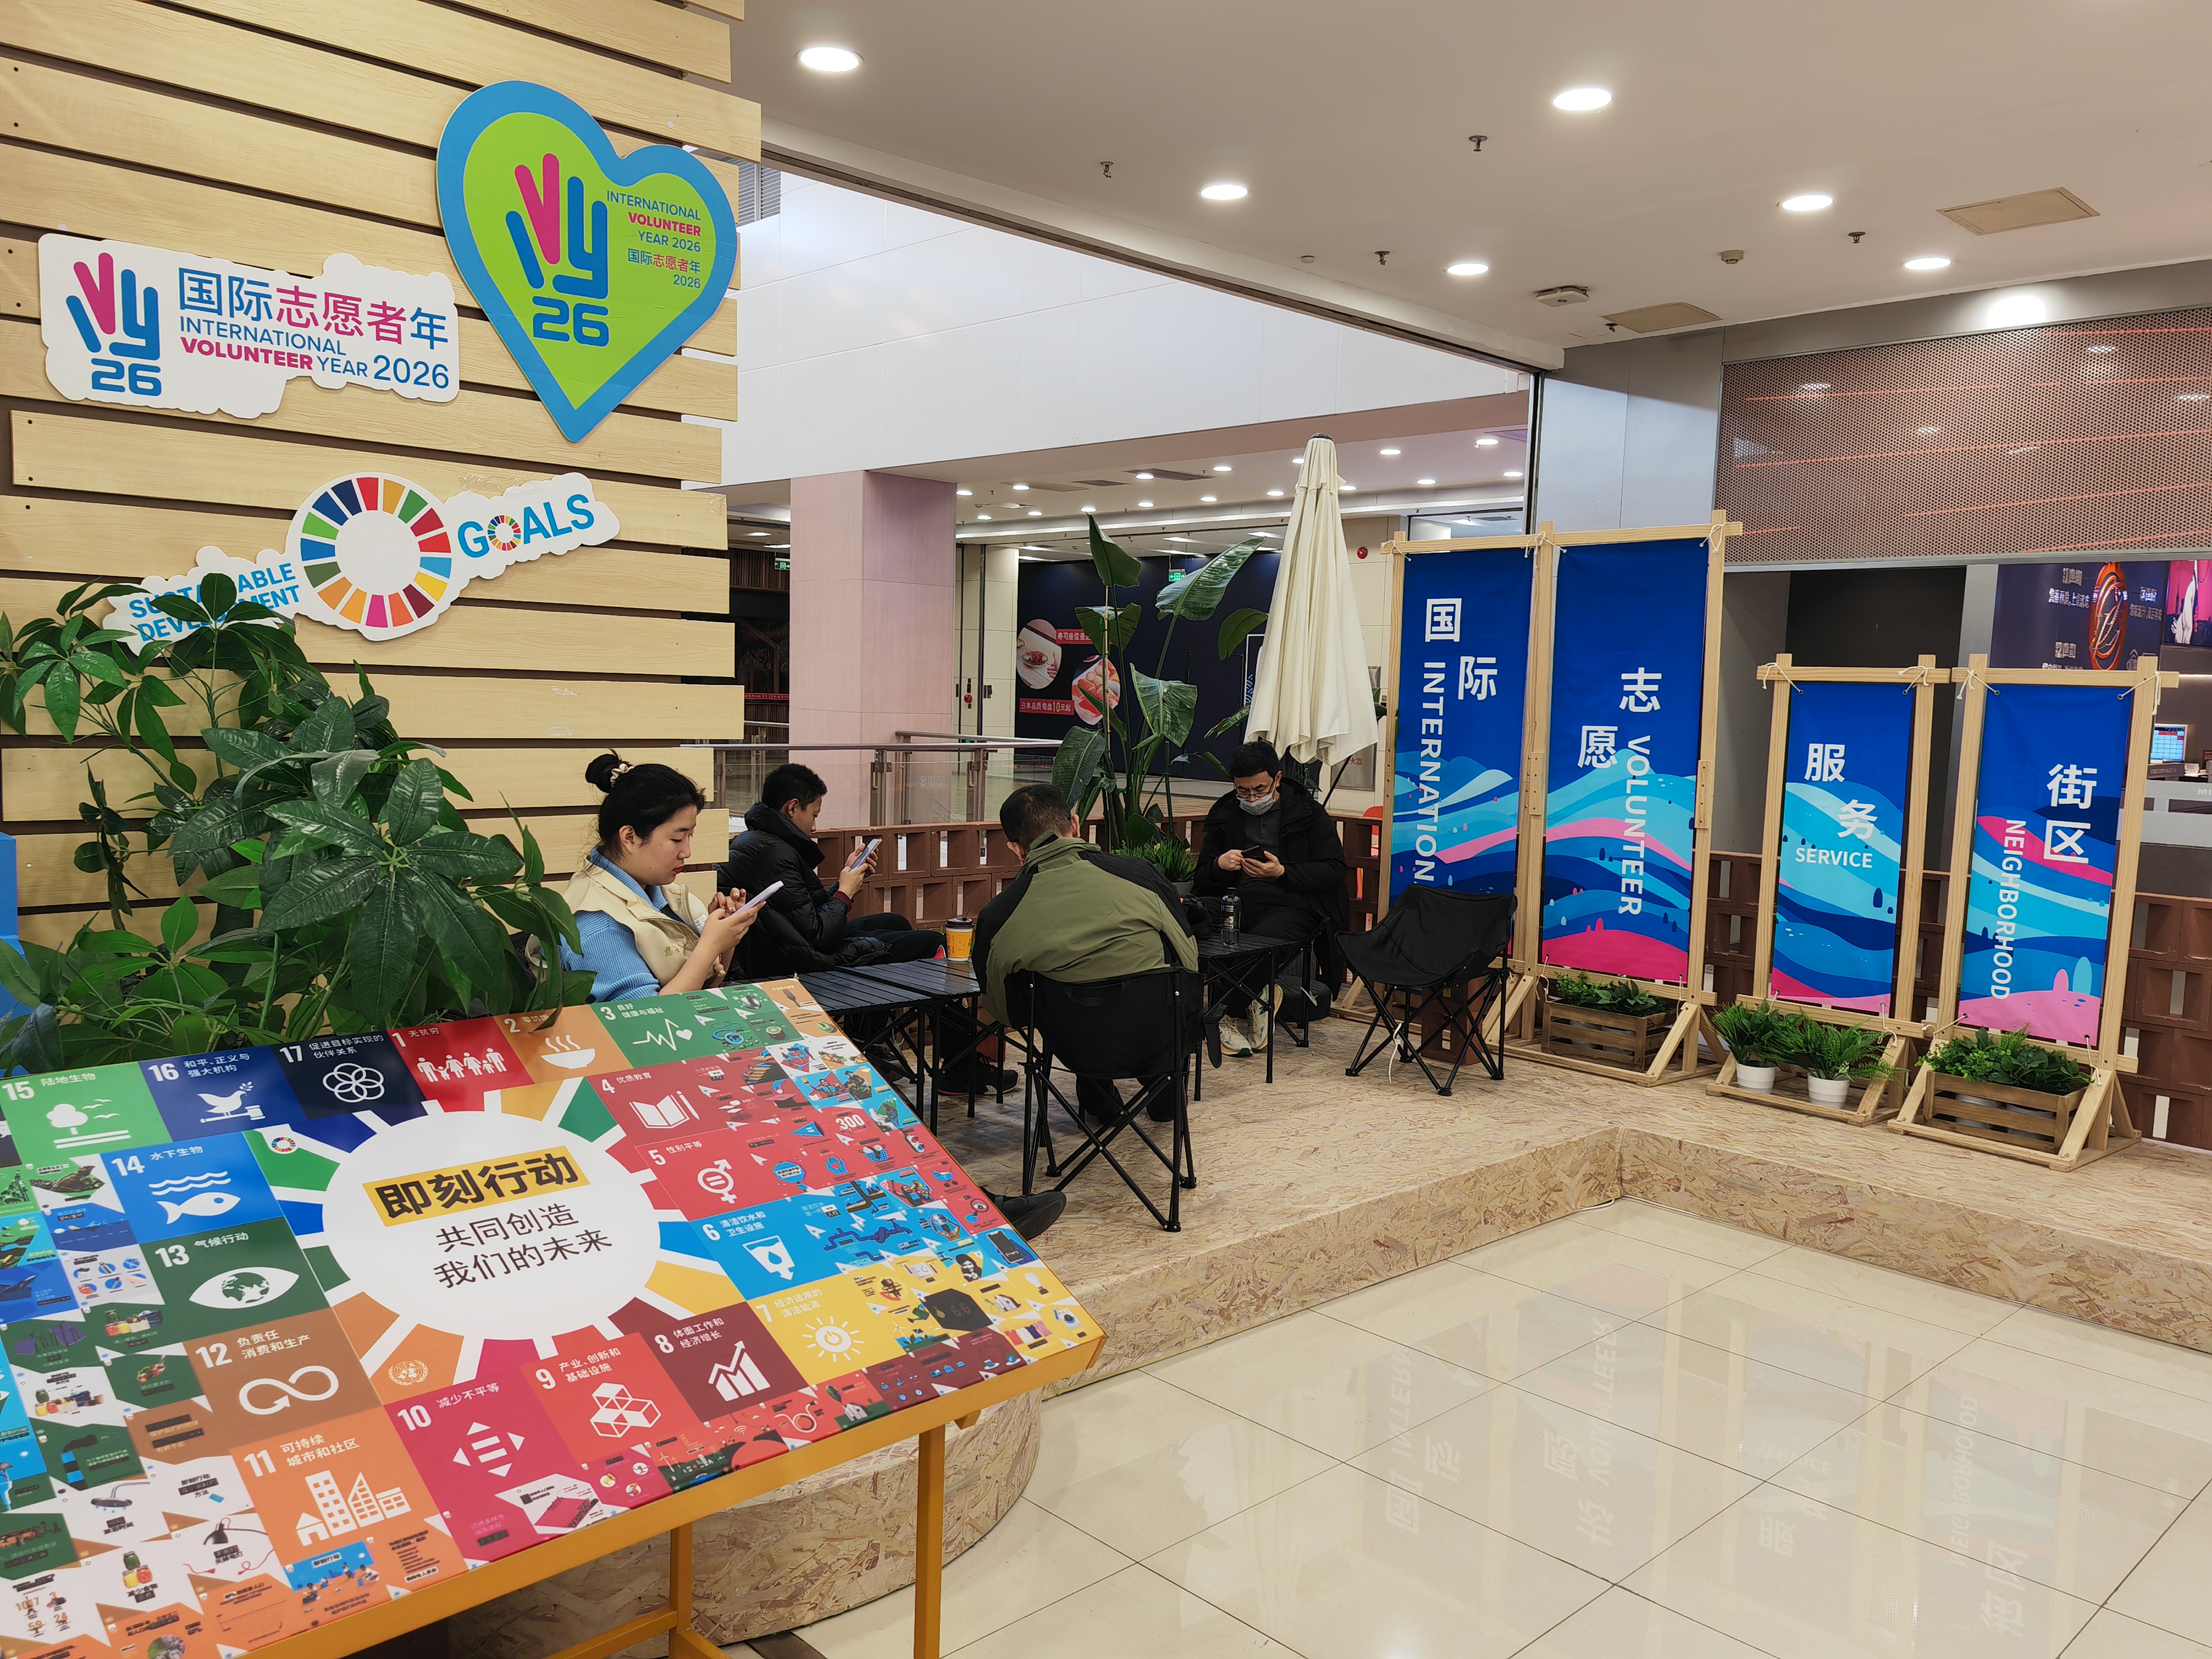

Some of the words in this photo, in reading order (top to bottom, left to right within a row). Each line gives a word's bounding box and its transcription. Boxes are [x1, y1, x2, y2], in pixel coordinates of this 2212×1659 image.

[607, 190, 701, 221] INTERNATIONAL
[628, 211, 701, 236] VOLUNTEER
[637, 230, 669, 247] YEAR
[672, 236, 701, 253] 2026
[628, 248, 701, 274] 国际志愿者年
[673, 274, 701, 289] 2026
[178, 267, 449, 350] 国际志愿者年
[532, 296, 609, 347] 26
[180, 315, 346, 356] INTERNATIONAL
[180, 337, 313, 370] VOLUNTEER
[316, 354, 368, 377] YEAR
[373, 354, 449, 389] 2026
[91, 358, 162, 397] 26
[2044, 764, 2098, 864] 街区
[1618, 735, 1651, 916] VOLUNTEER
[1795, 847, 1873, 868] SERVICE
[1991, 819, 2027, 1000] NEIGHBORHOOD
[600, 1006, 616, 1021] 3
[617, 1003, 634, 1012] 良好
[621, 1006, 664, 1019] 健康与福祉
[408, 1027, 439, 1038] 无贫穷
[504, 1018, 521, 1033] 2
[308, 1035, 385, 1051] 促进目标实现的
[391, 1032, 407, 1047] 1
[183, 1052, 250, 1069] 和平、正义与
[279, 1045, 303, 1063] 17
[313, 1046, 358, 1059] 伙伴关系
[41, 1072, 96, 1087] 陆地生物
[148, 1063, 179, 1083] 16
[187, 1063, 238, 1078] 强大机构
[616, 1071, 652, 1084] 优质教育
[2, 1081, 35, 1101] 15
[601, 1079, 616, 1094] 4
[836, 1114, 865, 1131] 300
[149, 1146, 204, 1161] 水下生物
[665, 1140, 703, 1154] 性别平等
[111, 1155, 145, 1177] 14
[648, 1149, 666, 1166] 5
[374, 1153, 579, 1219] 即刻行动
[436, 1203, 579, 1253] 共同创造
[719, 1210, 766, 1228] 清洁饮水和
[726, 1221, 765, 1237] 卫生设施
[194, 1232, 249, 1249] 气候行动
[702, 1223, 721, 1241] 6
[154, 1244, 190, 1268] 13
[432, 1228, 613, 1289] 我们的未来
[774, 1288, 823, 1309] 经济适用的
[756, 1304, 774, 1323] 7
[781, 1300, 821, 1318] 清洁能源
[236, 1329, 280, 1347] 负责任
[673, 1318, 725, 1339] 体面工作和
[242, 1333, 311, 1360] 消费和生产
[654, 1334, 675, 1353] 8
[679, 1329, 723, 1350] 经济增长
[195, 1342, 233, 1368] 12
[558, 1347, 622, 1372] 产业、创新和
[535, 1368, 556, 1390] 9
[565, 1362, 613, 1384] 基础设施
[436, 1382, 500, 1409] 减少不平等
[397, 1404, 432, 1431] 10
[280, 1434, 326, 1454] 可持续
[286, 1437, 360, 1467] 城市和社区
[243, 1449, 276, 1477] 11
